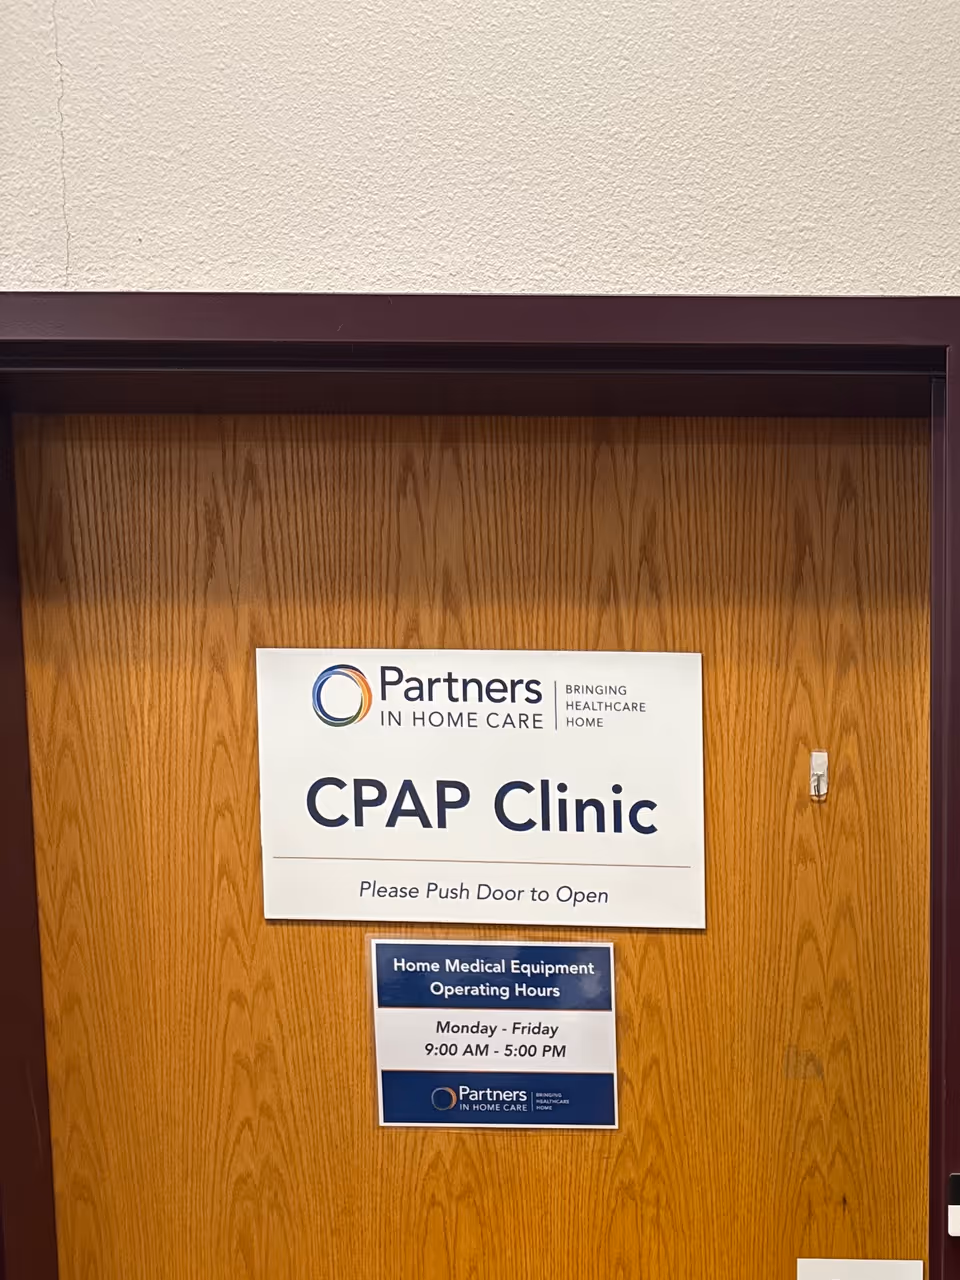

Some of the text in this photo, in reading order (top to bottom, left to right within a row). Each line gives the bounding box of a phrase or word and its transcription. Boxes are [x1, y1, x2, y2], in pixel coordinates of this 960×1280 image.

[380, 666, 543, 704] Partners
[565, 684, 627, 696] BRINGING
[565, 701, 646, 713] HEALTHCARE
[380, 711, 544, 729] IN HOME CARE
[565, 717, 604, 728] HOME
[306, 777, 658, 834] CPAP Clinic
[359, 881, 609, 906] Please Push Door to Open
[393, 958, 595, 977] Home Medical Equipment
[430, 982, 561, 999] Operating Hours
[436, 1021, 498, 1038] Monday
[512, 1022, 559, 1038] Friday
[425, 1043, 458, 1056] 9:00
[463, 1044, 489, 1056] AM
[504, 1045, 537, 1057] 5:00
[542, 1045, 566, 1058] PM
[459, 1086, 528, 1101] Partners
[503, 1104, 528, 1112] CARE
